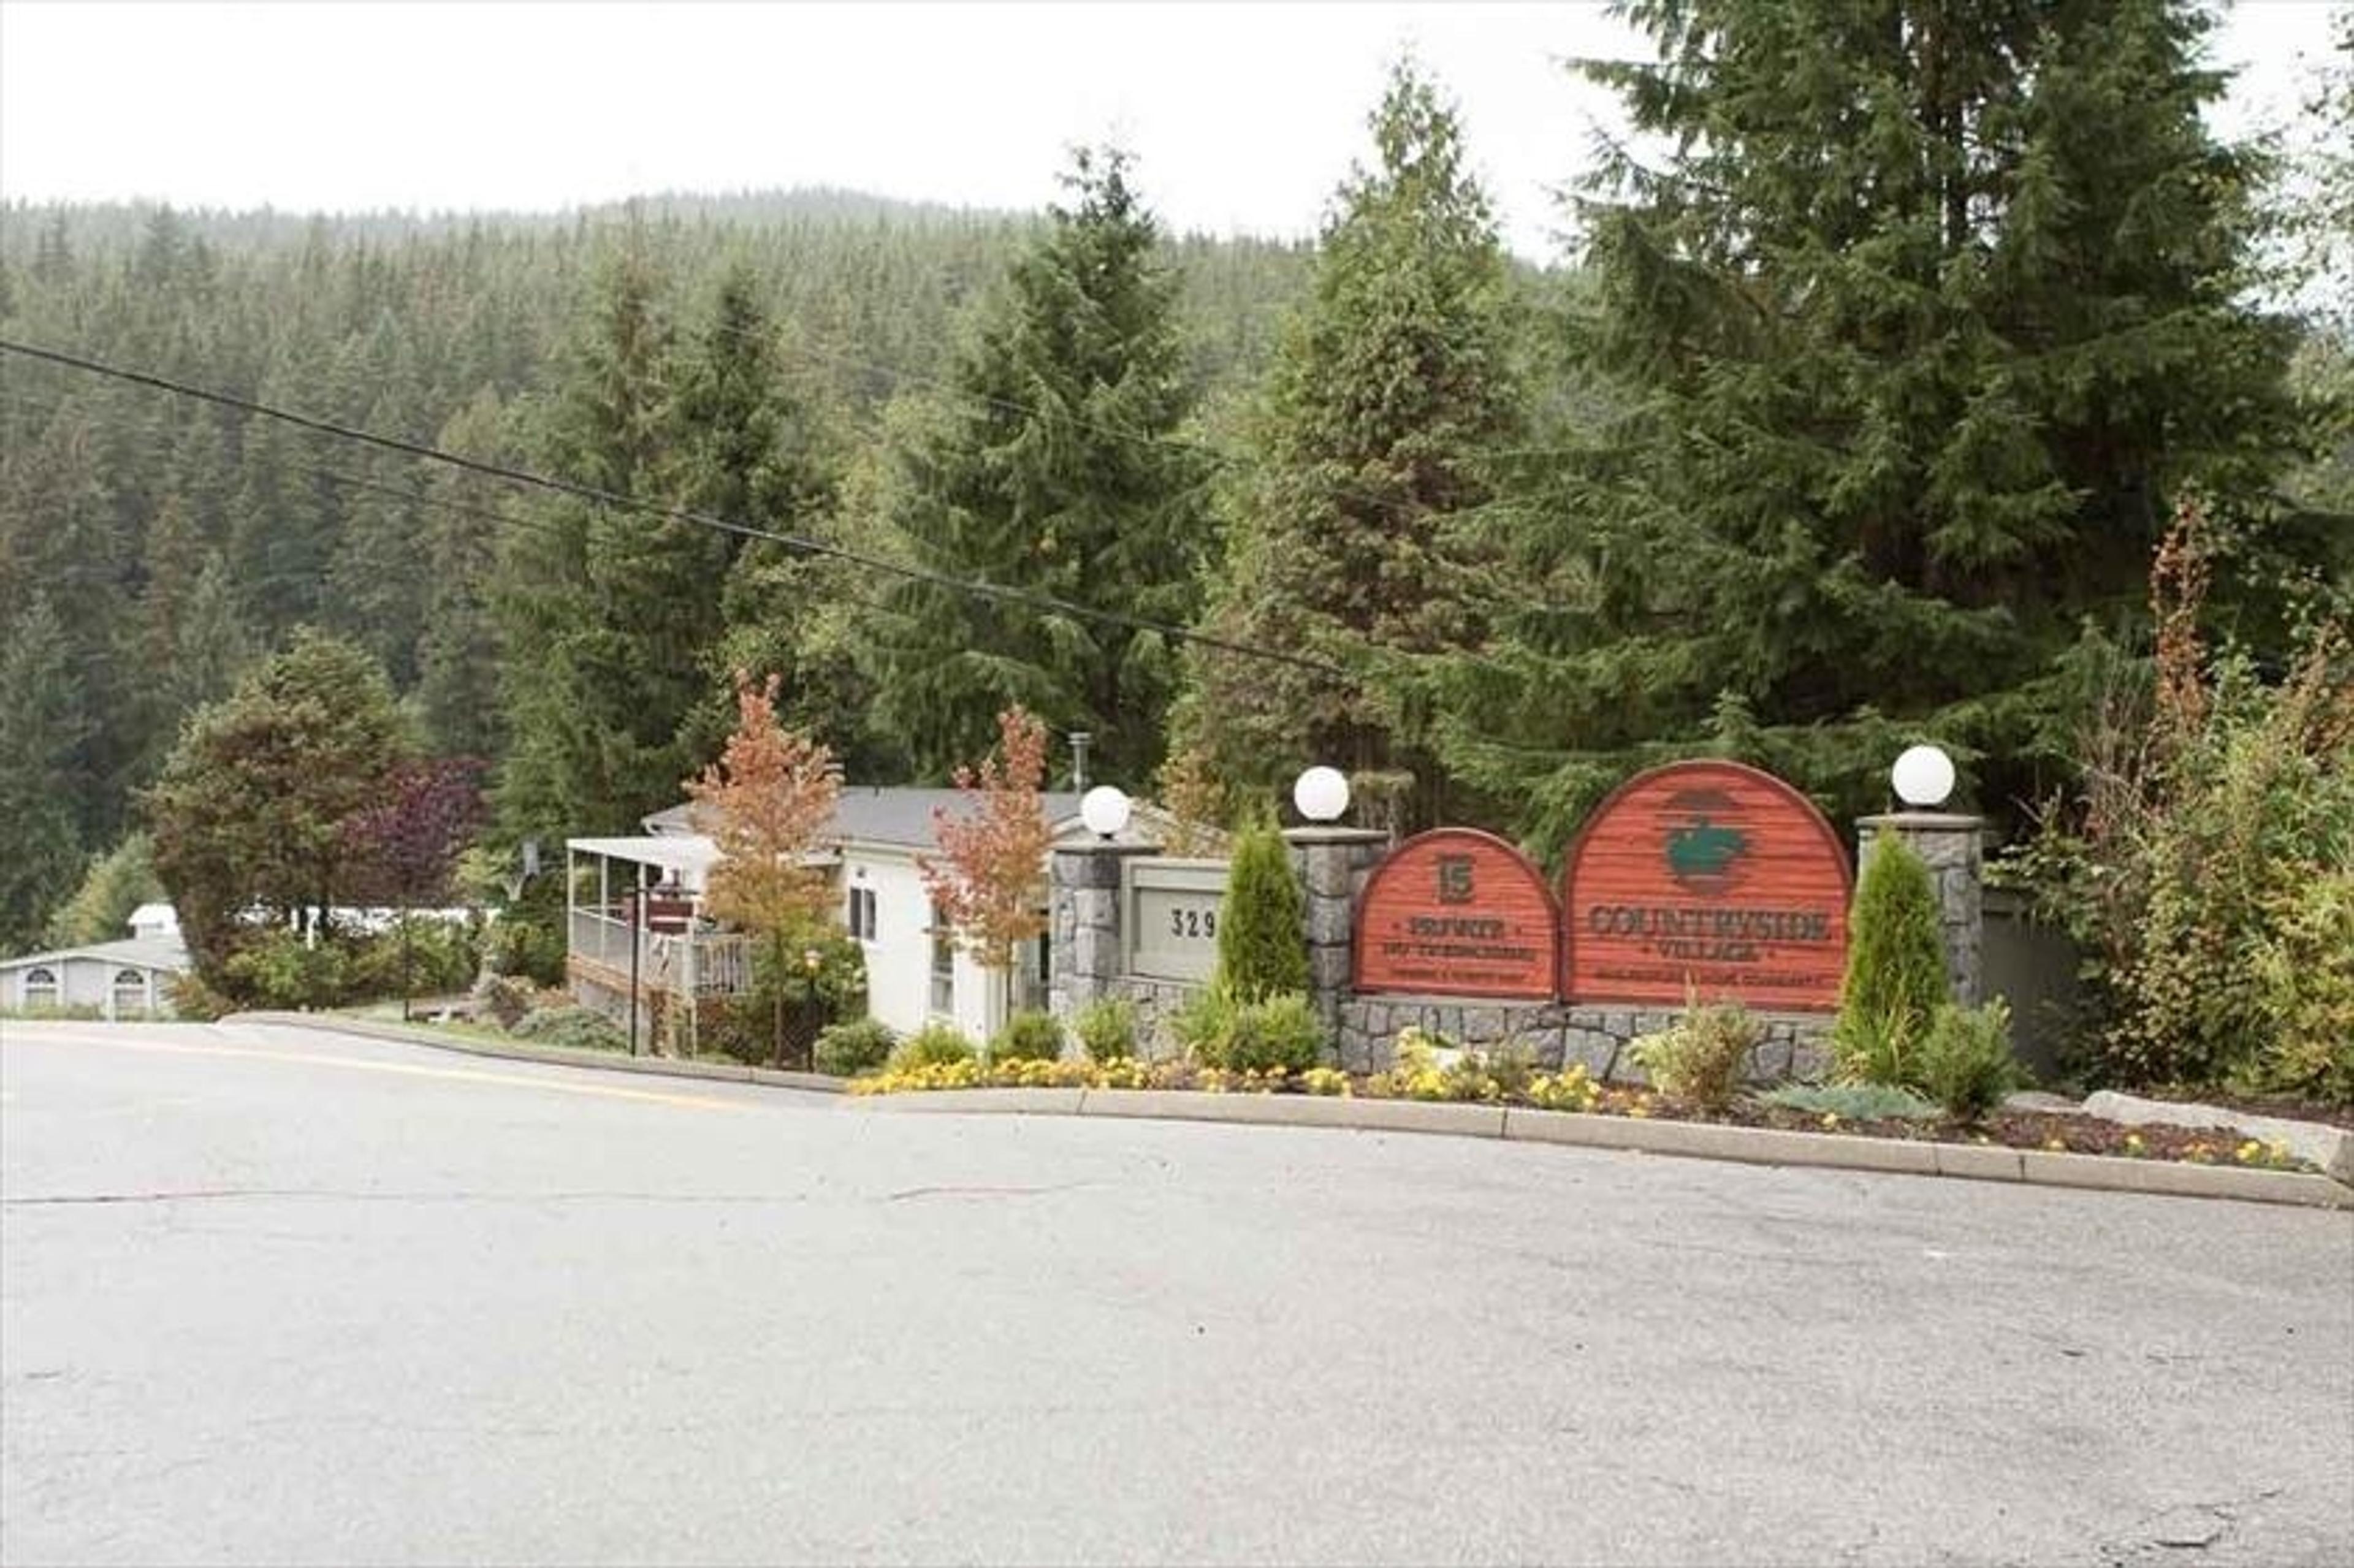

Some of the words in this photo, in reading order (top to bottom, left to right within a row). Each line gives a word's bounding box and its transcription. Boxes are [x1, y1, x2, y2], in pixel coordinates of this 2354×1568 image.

[1170, 908, 1215, 938] 329
[1590, 905, 1832, 940] COUNTRYSIDE
[1657, 939, 1761, 962] VILLAGE
